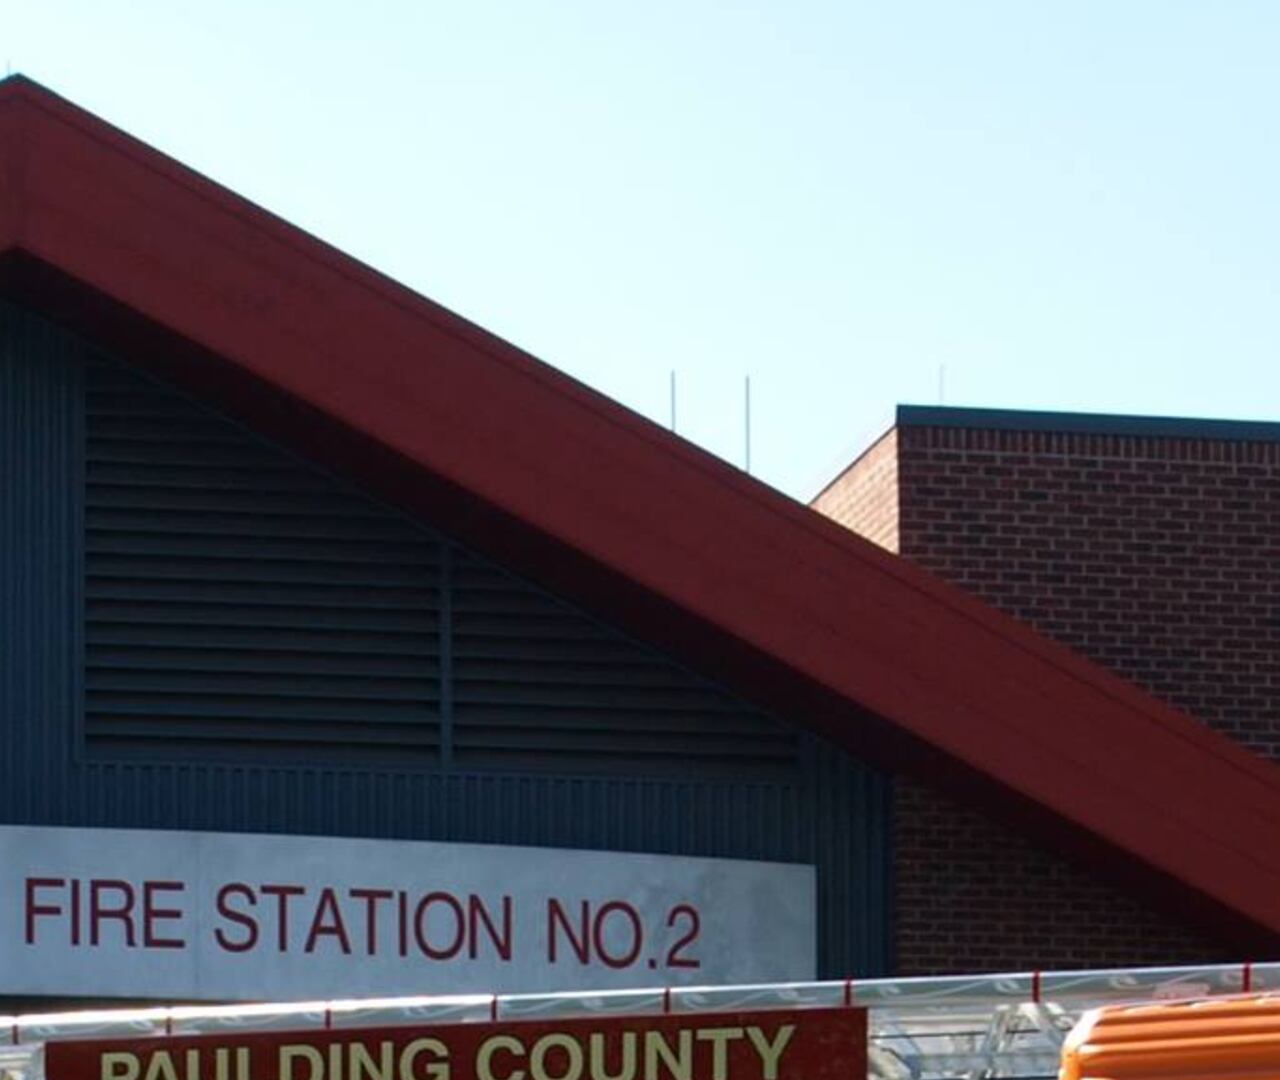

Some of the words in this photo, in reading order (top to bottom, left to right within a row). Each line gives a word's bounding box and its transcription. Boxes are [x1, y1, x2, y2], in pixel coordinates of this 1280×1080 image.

[24, 877, 186, 948] FIRE
[214, 882, 513, 961] STATION
[547, 898, 701, 969] NO.2
